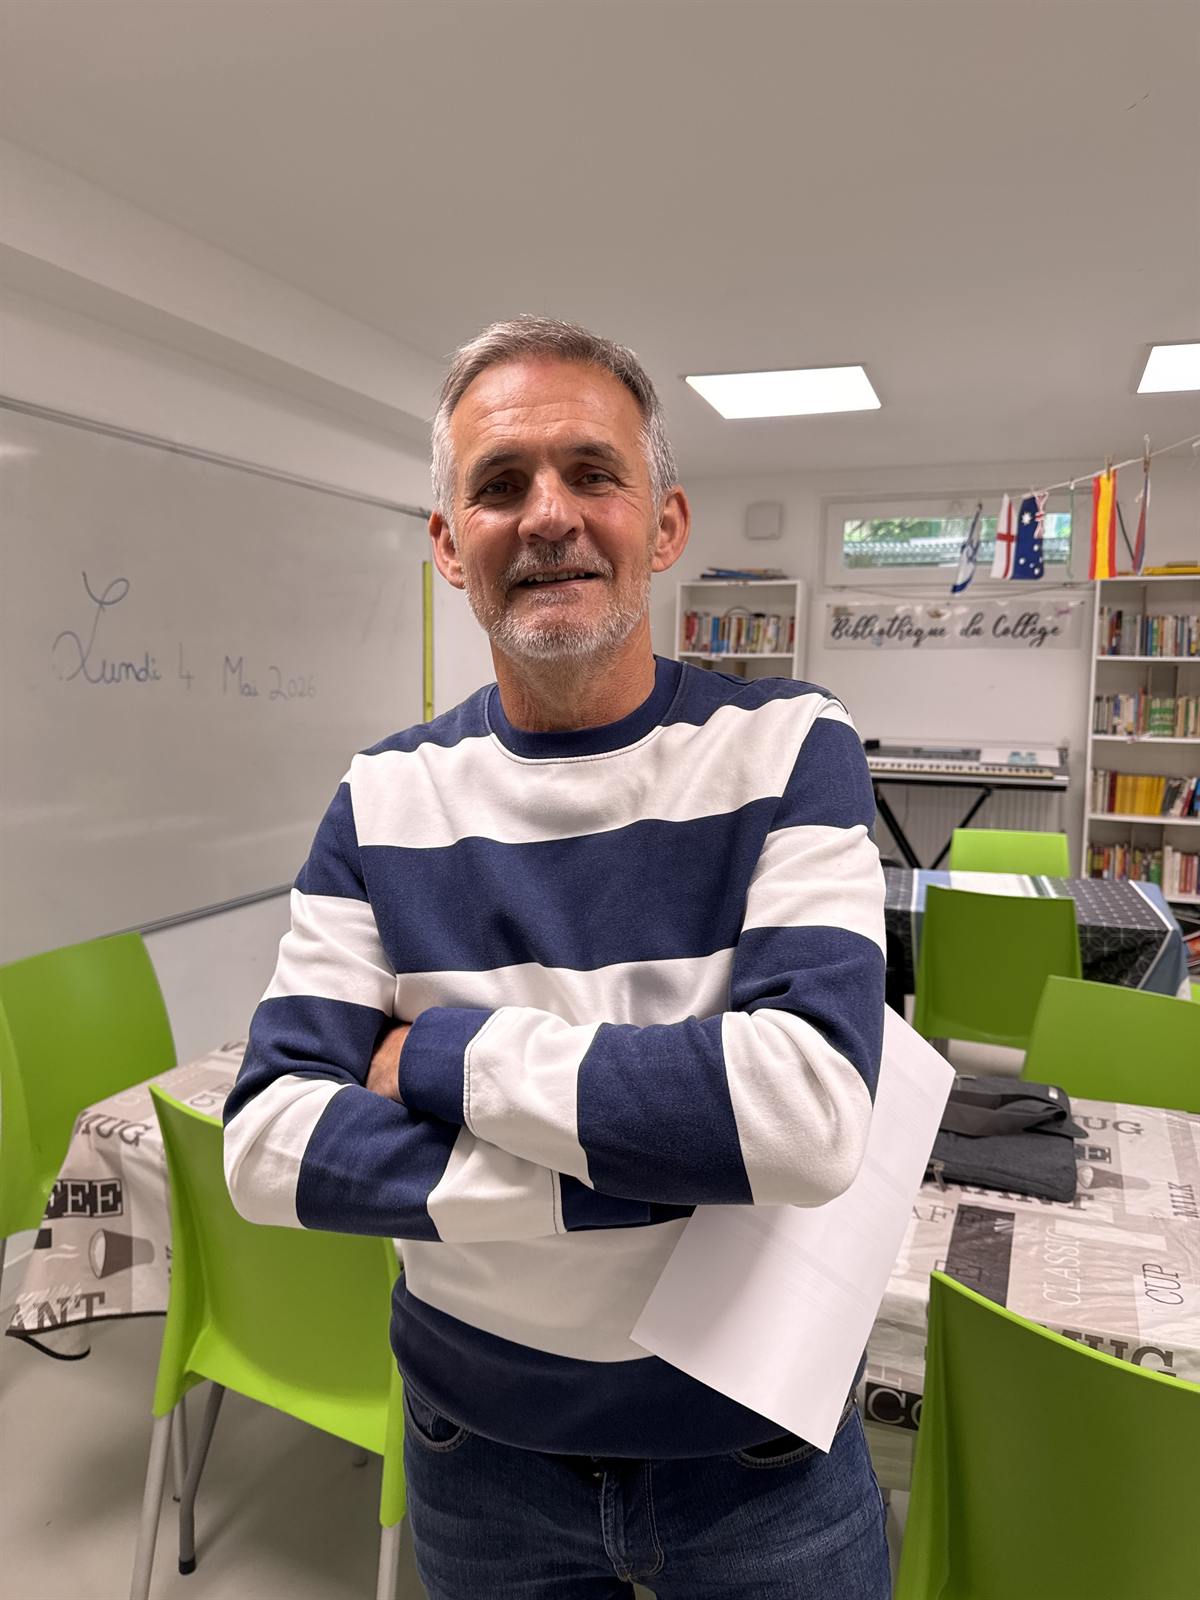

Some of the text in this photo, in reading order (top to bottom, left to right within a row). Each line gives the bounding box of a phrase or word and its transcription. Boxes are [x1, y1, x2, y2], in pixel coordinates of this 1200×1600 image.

[52, 571, 318, 701] Lundi 4 Mai 2026
[959, 612, 985, 637] du
[1168, 1181, 1199, 1218] MILK
[1043, 1226, 1081, 1305] CLASSIC
[1142, 1263, 1184, 1305] CUP
